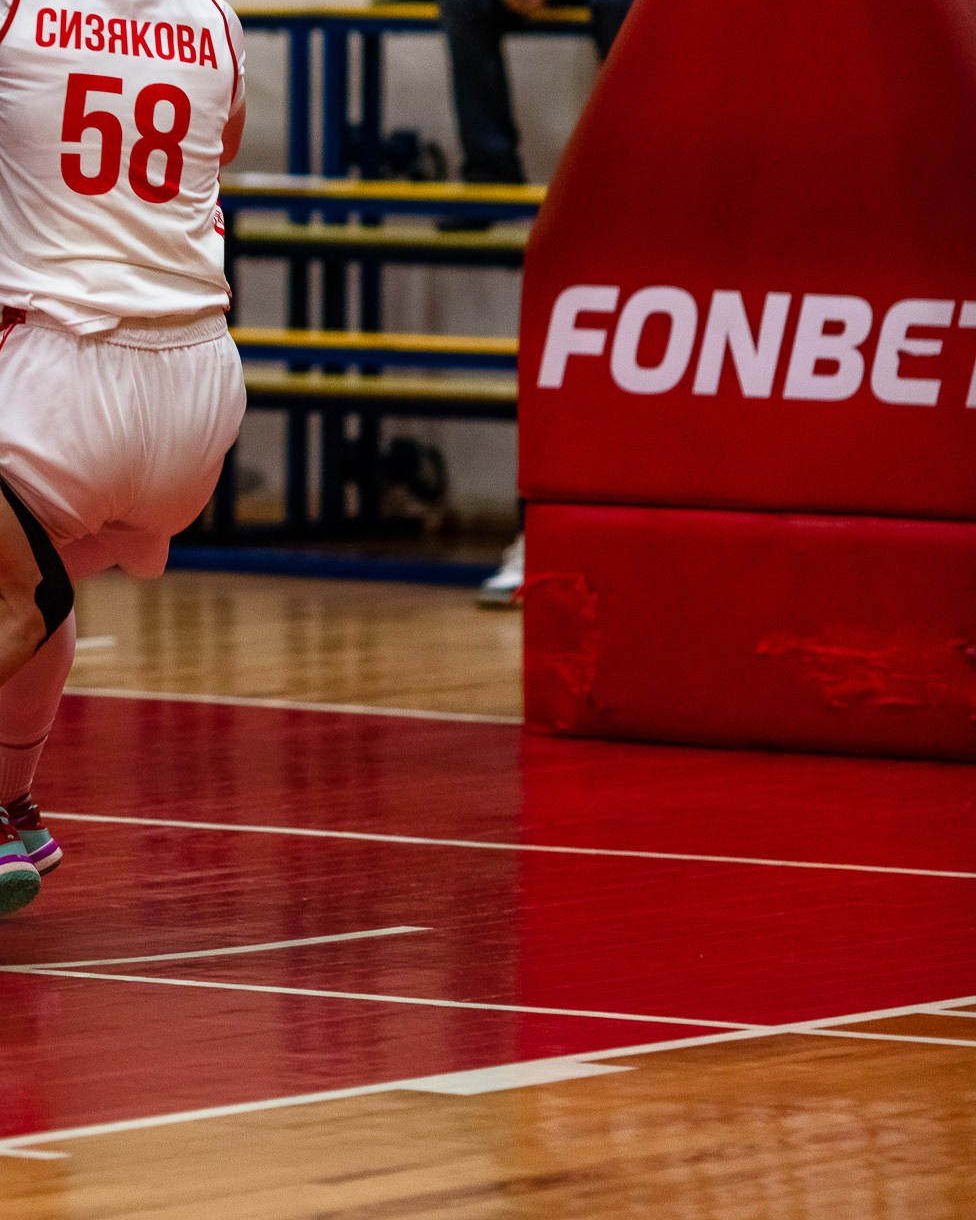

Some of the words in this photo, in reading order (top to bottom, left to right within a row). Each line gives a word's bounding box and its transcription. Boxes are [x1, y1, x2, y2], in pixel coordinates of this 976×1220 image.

[35, 7, 218, 70] СИЗЯКОВА
[60, 72, 192, 204] 58
[536, 283, 976, 410] FONBE
